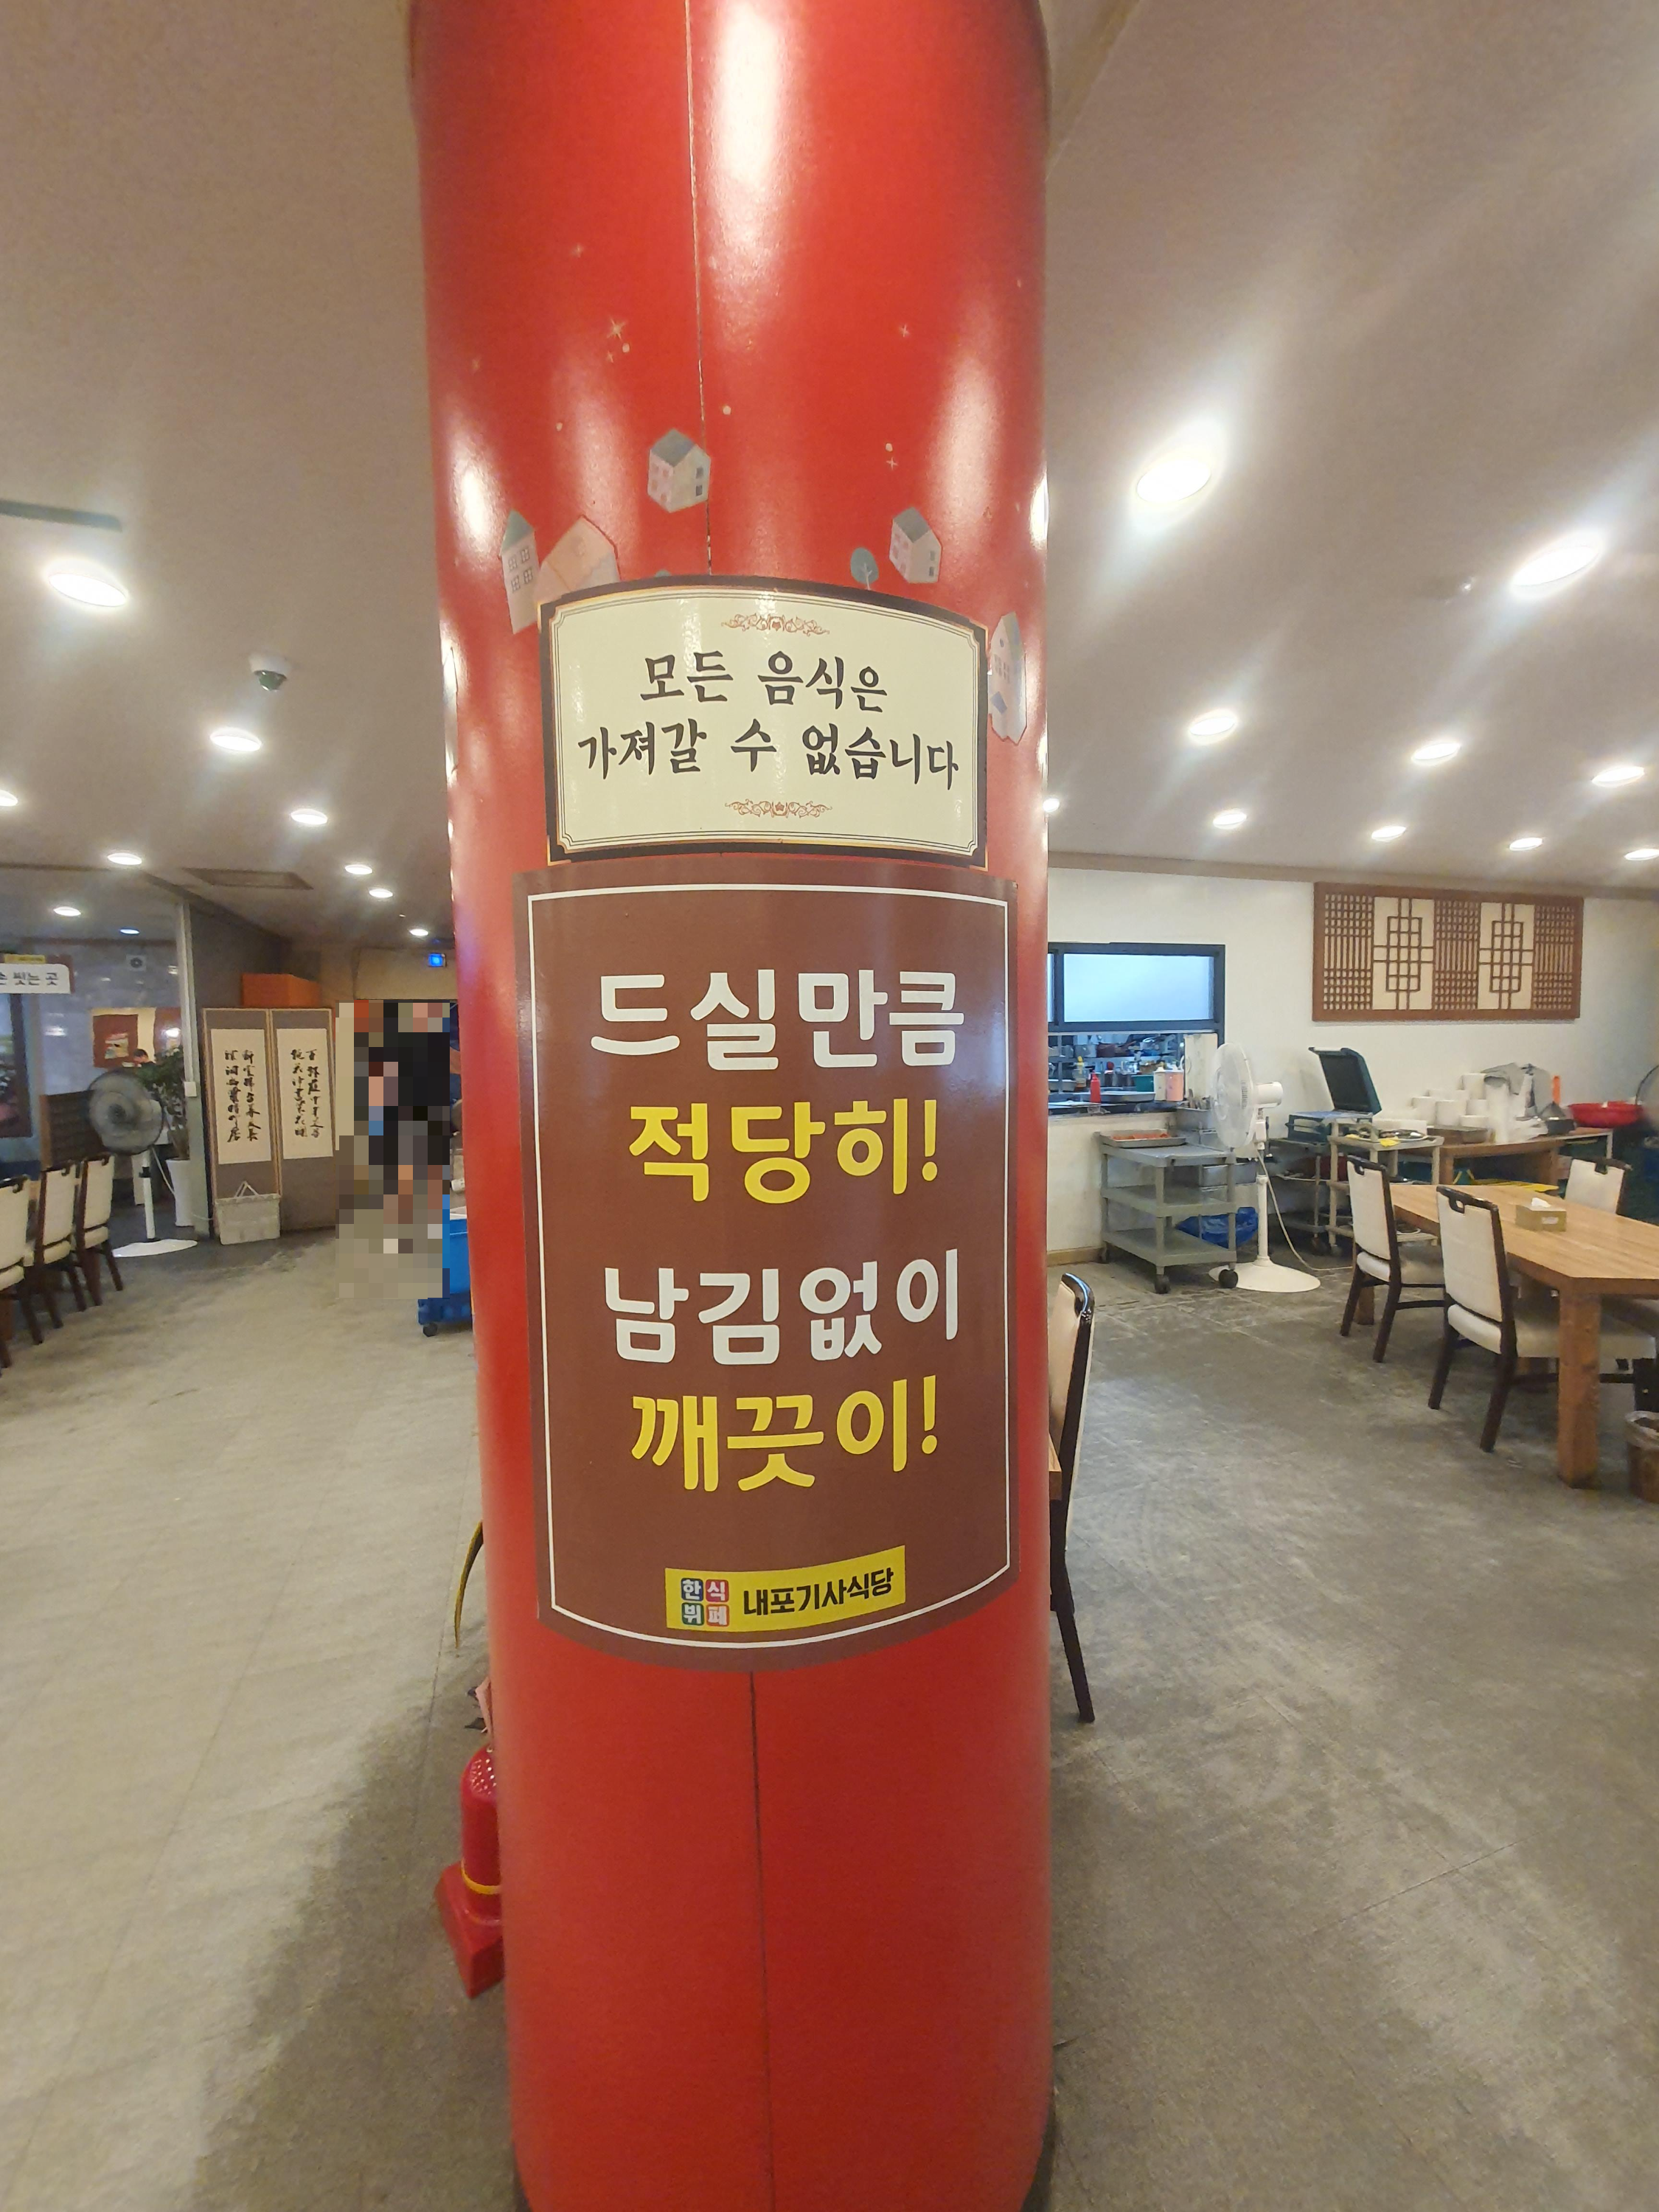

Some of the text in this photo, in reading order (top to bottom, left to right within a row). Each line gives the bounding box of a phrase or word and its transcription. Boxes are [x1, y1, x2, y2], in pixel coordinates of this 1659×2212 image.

[639, 650, 888, 713] 모든 음식은
[577, 718, 959, 791] 가져갈 수 없습니다
[591, 969, 964, 1071] 드실만큼
[629, 1098, 939, 1204] 적당히!
[604, 1248, 959, 1366] 남김없이
[631, 1374, 938, 1492] 깨끗이!
[682, 1579, 726, 1601] 한식
[683, 1604, 728, 1626] 뷔페
[742, 1567, 894, 1616] 내포기사식당
